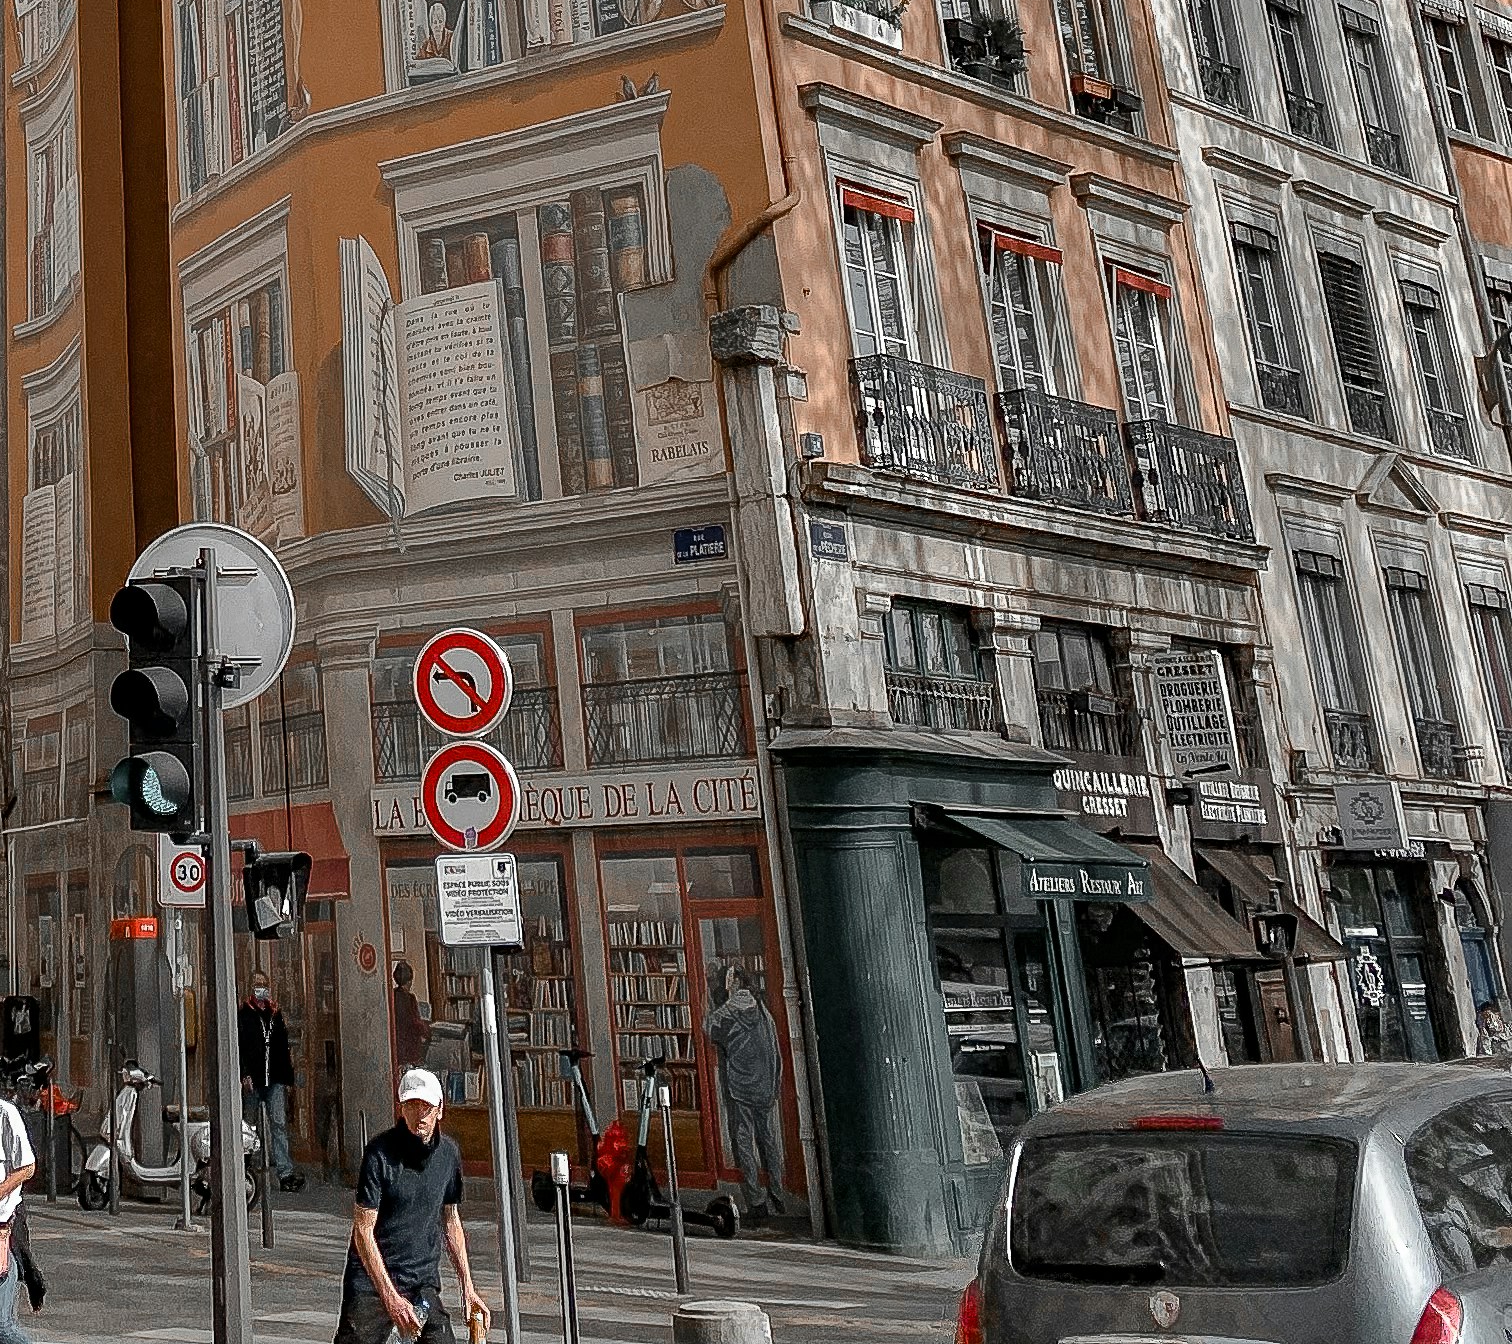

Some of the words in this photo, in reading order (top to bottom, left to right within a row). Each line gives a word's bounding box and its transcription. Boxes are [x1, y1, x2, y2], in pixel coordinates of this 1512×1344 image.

[553, 3, 564, 33] 1941
[448, 401, 466, 412] dans
[448, 413, 476, 426] encore
[480, 410, 498, 422] plus
[451, 429, 464, 439] que
[454, 437, 488, 453] pousser
[651, 441, 709, 462] RABELAIS
[480, 465, 504, 479] JULIET
[689, 540, 726, 557] PLATIÈRE
[1159, 681, 1220, 697] DROGUERIE
[1162, 698, 1224, 714] PLOMBERIE
[1166, 713, 1226, 731] OUTILLAGE
[1053, 769, 1150, 797] QUINCAILLERIE
[374, 798, 404, 831] LA
[604, 781, 637, 818] DE
[646, 778, 685, 815] LA
[692, 769, 758, 814] CITÉ
[177, 864, 200, 881] 30
[443, 881, 466, 889] ESPACE
[468, 880, 491, 888] PUBLIC
[446, 889, 466, 898] VIDÉO
[468, 888, 508, 896] PROTECTION
[445, 910, 465, 918] VIDÉO
